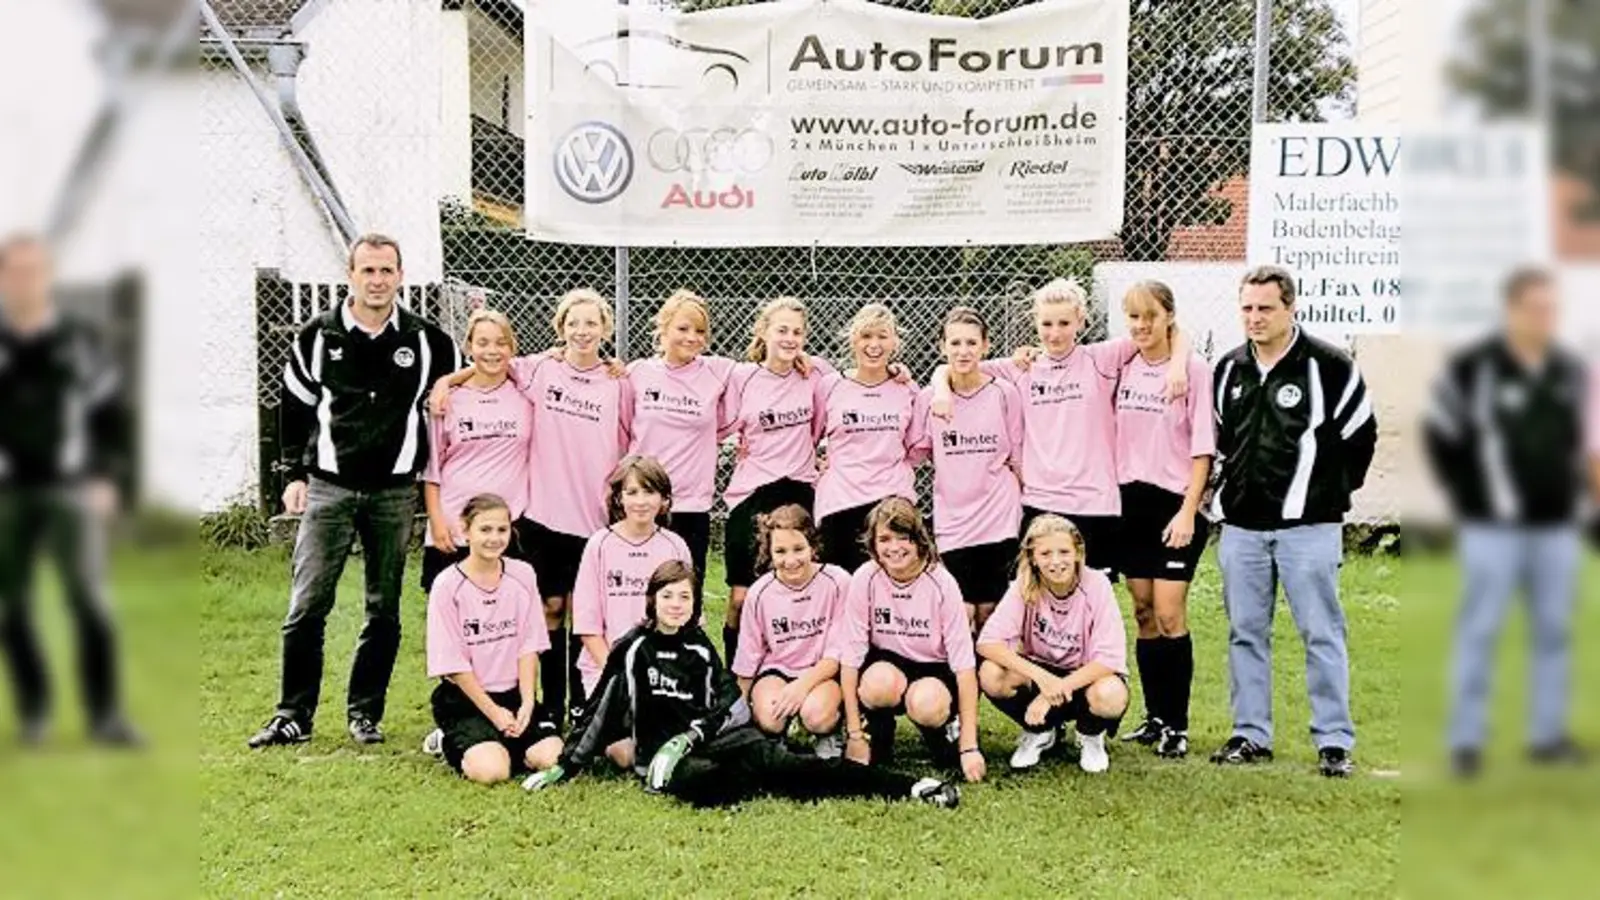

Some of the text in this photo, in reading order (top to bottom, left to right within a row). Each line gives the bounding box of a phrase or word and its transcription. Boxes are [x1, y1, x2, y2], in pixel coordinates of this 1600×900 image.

[790, 33, 1103, 73] AutoForum
[787, 78, 867, 92] GEMEINSAM
[881, 79, 919, 92] STARK
[921, 79, 954, 94] UND
[957, 78, 1036, 93] KOMPETENT
[791, 103, 1097, 136] www.auto-forum.de
[790, 139, 798, 150] 2
[818, 138, 898, 151] München
[1009, 159, 1069, 178] Riedel
[660, 183, 755, 209] Audi
[1272, 192, 1398, 212] Malerfachb
[1272, 218, 1400, 243] Bodenbelag
[1270, 246, 1400, 270] Teppichrein
[1297, 278, 1361, 297] l./Fax
[1293, 304, 1372, 324] obiltel.
